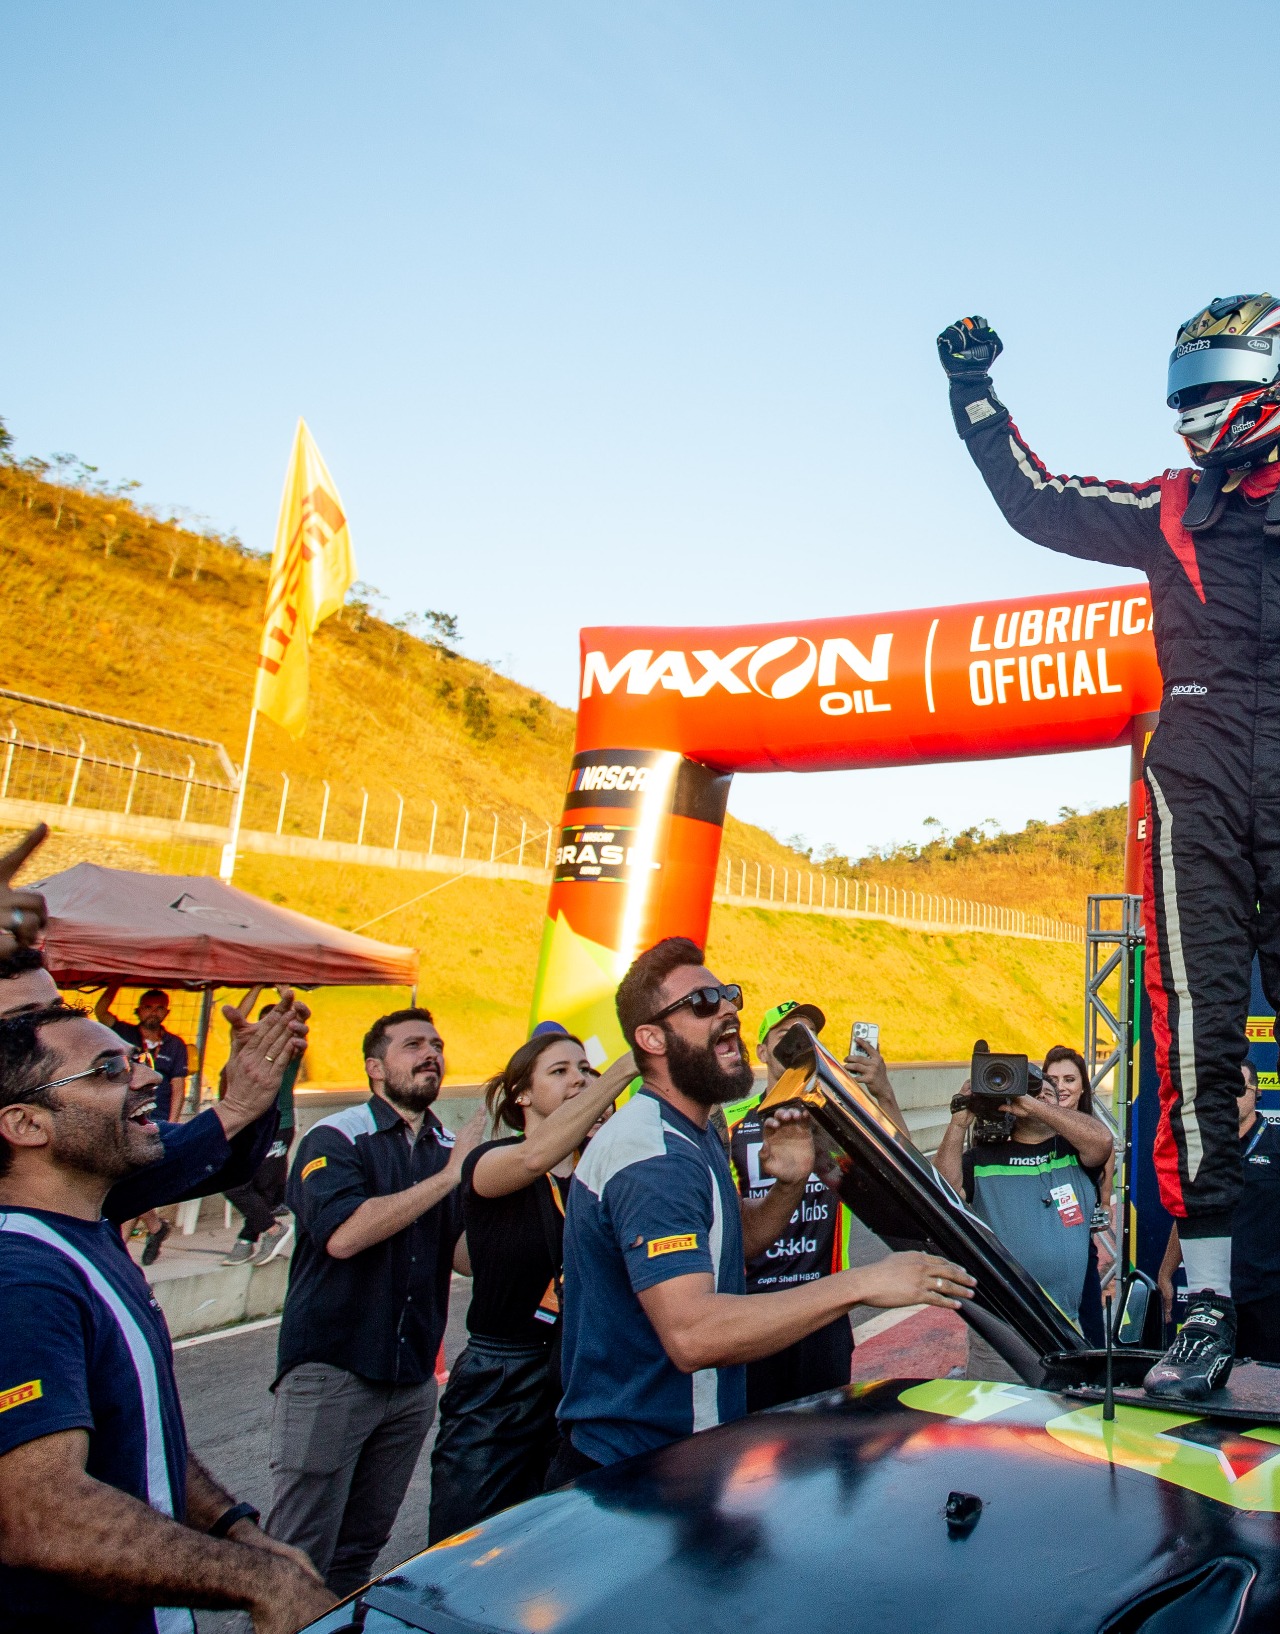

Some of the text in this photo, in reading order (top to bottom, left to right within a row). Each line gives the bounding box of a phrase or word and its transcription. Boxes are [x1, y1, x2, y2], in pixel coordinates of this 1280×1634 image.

[970, 597, 1153, 652] LUBRIFIC
[582, 633, 893, 699] MAXON
[969, 648, 1122, 706] OFICIAL
[820, 689, 892, 715] OIL
[1171, 684, 1207, 695] sparco
[653, 1237, 692, 1252] PIRELLI
[800, 1272, 820, 1281] HB20
